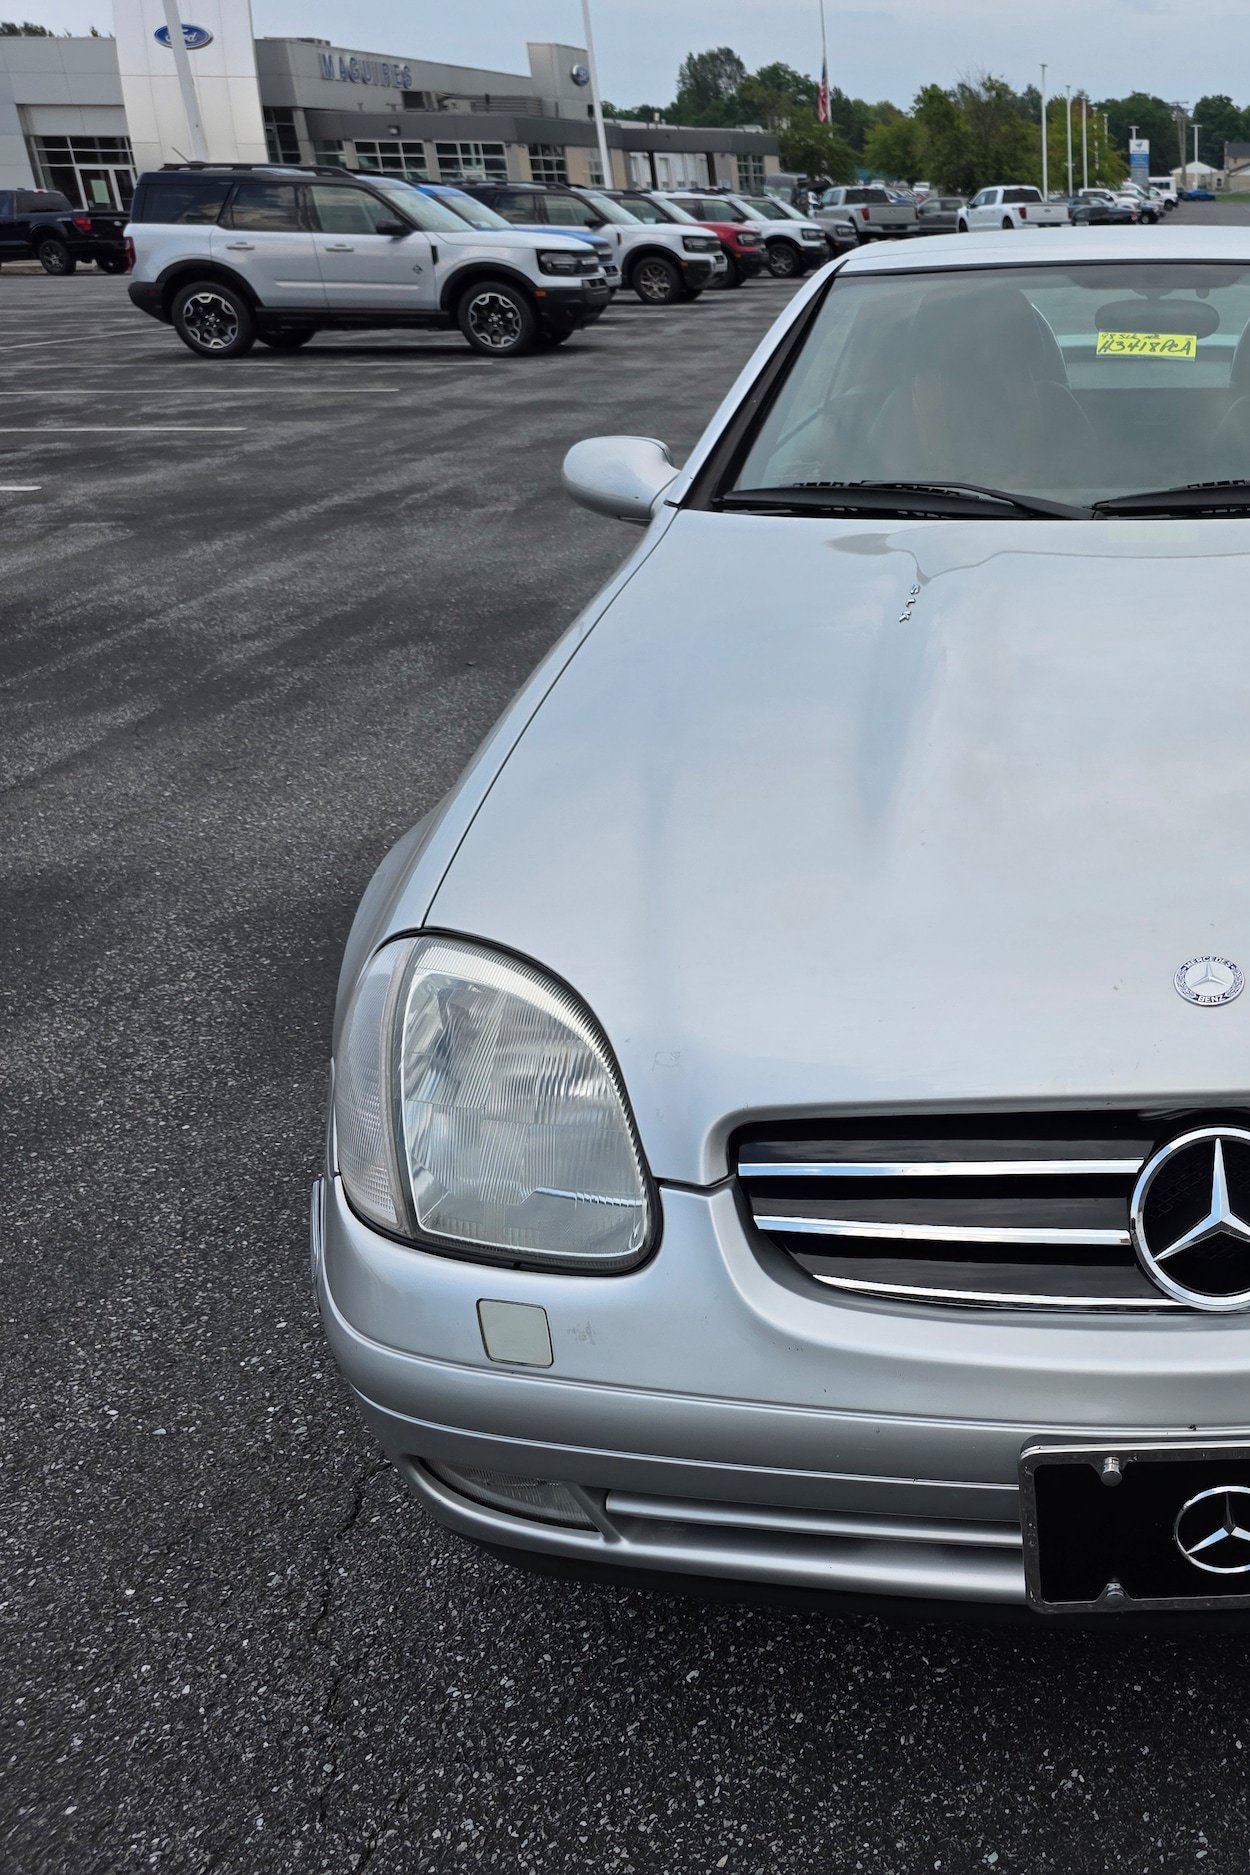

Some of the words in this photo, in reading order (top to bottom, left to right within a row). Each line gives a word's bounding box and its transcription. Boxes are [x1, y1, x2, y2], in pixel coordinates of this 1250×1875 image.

[319, 52, 413, 89] MAGUIRES
[1184, 956, 1232, 969] MERCEDES
[1197, 994, 1226, 1004] BENZ
